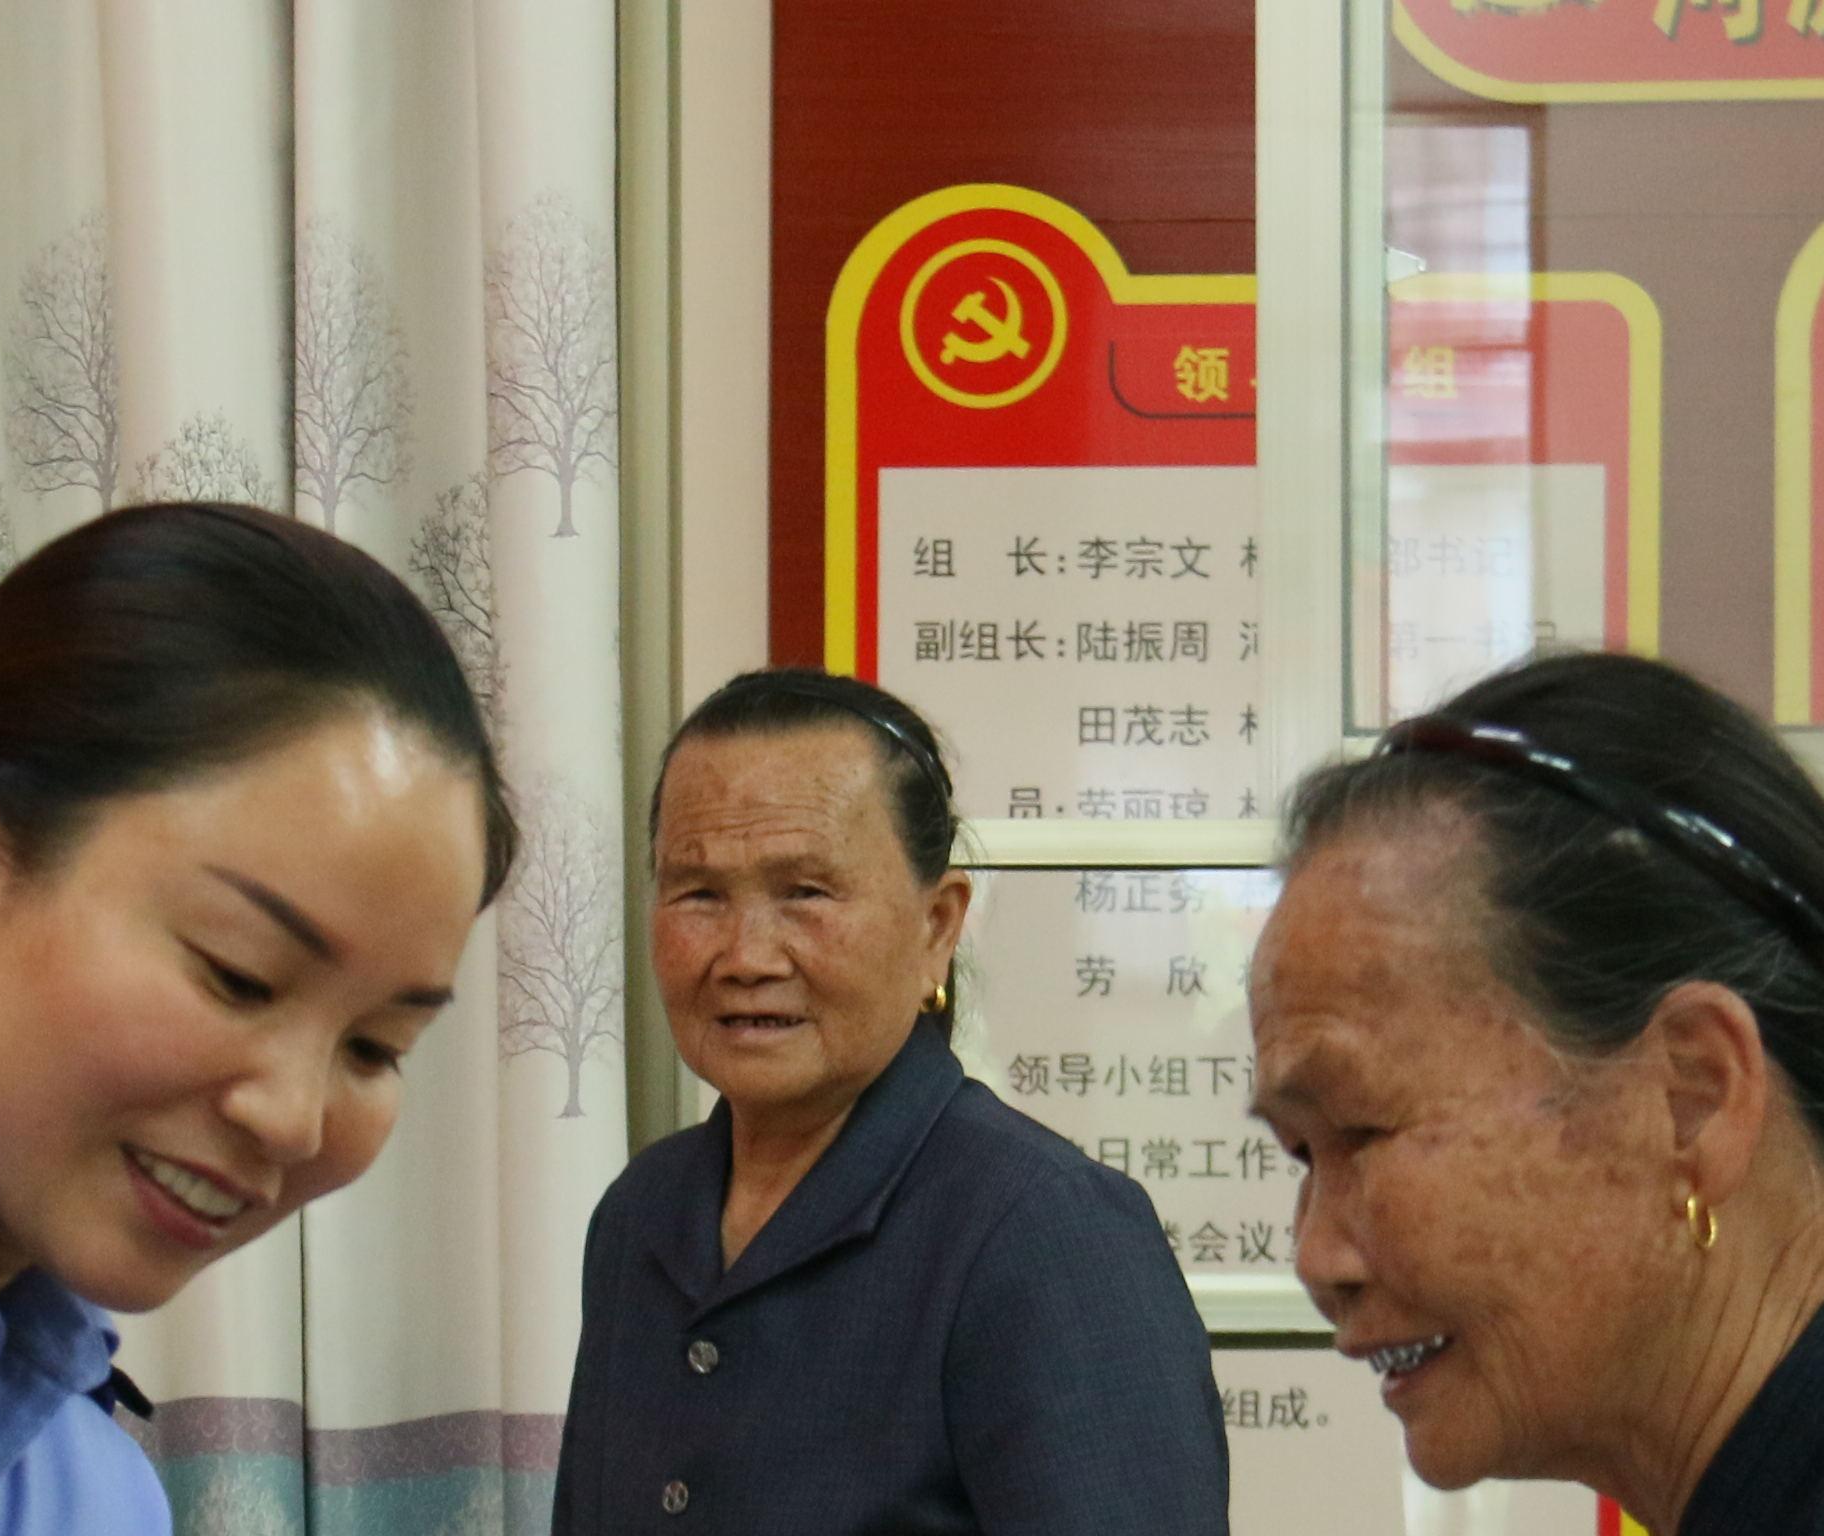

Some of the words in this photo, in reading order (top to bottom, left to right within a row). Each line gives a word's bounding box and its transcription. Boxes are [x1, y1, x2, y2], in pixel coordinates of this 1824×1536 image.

[1077, 705, 1211, 747] 田茂志
[1076, 1137, 1301, 1181] 日常工作。
